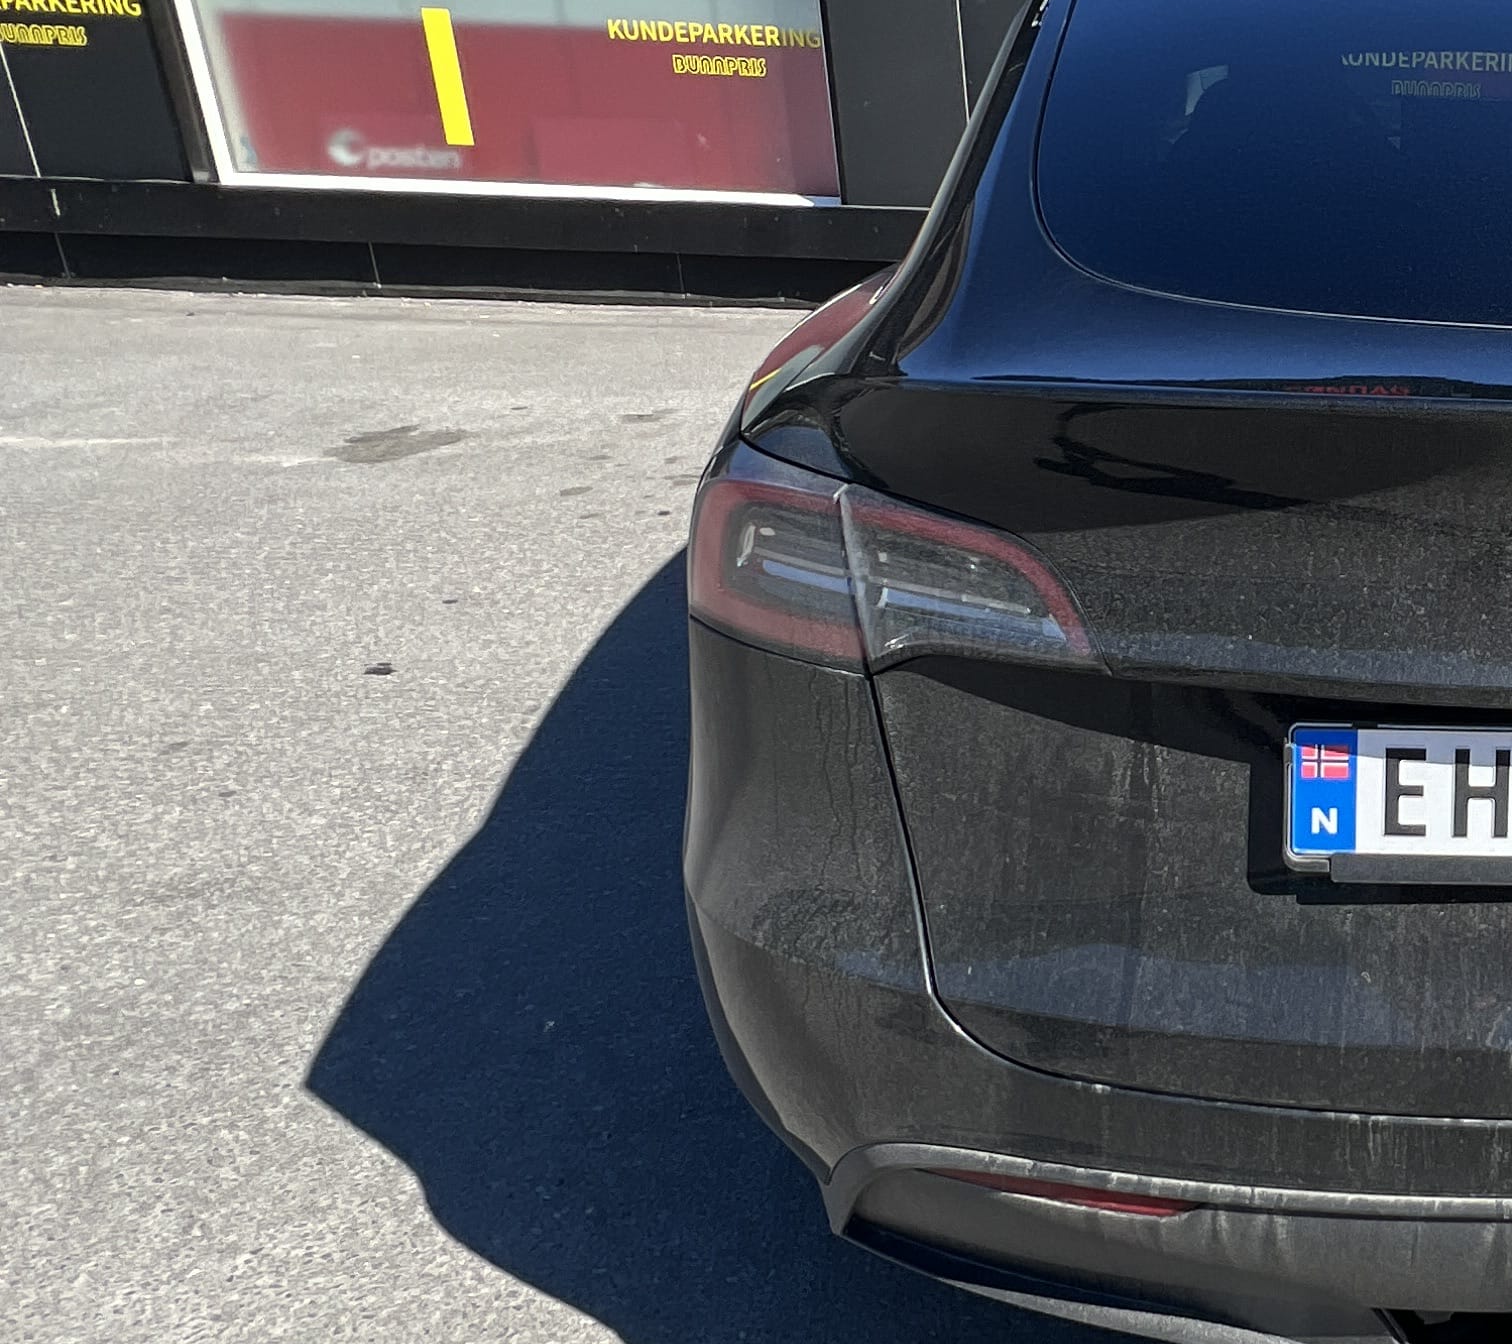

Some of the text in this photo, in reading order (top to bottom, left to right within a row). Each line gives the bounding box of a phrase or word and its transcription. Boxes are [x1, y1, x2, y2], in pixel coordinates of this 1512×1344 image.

[0, 22, 88, 46] UNNPRIS
[607, 18, 822, 49] KUNDEPARKERING
[672, 54, 766, 77] BUNNPRIS
[1382, 747, 1510, 838] EH
[1310, 807, 1338, 834] N
